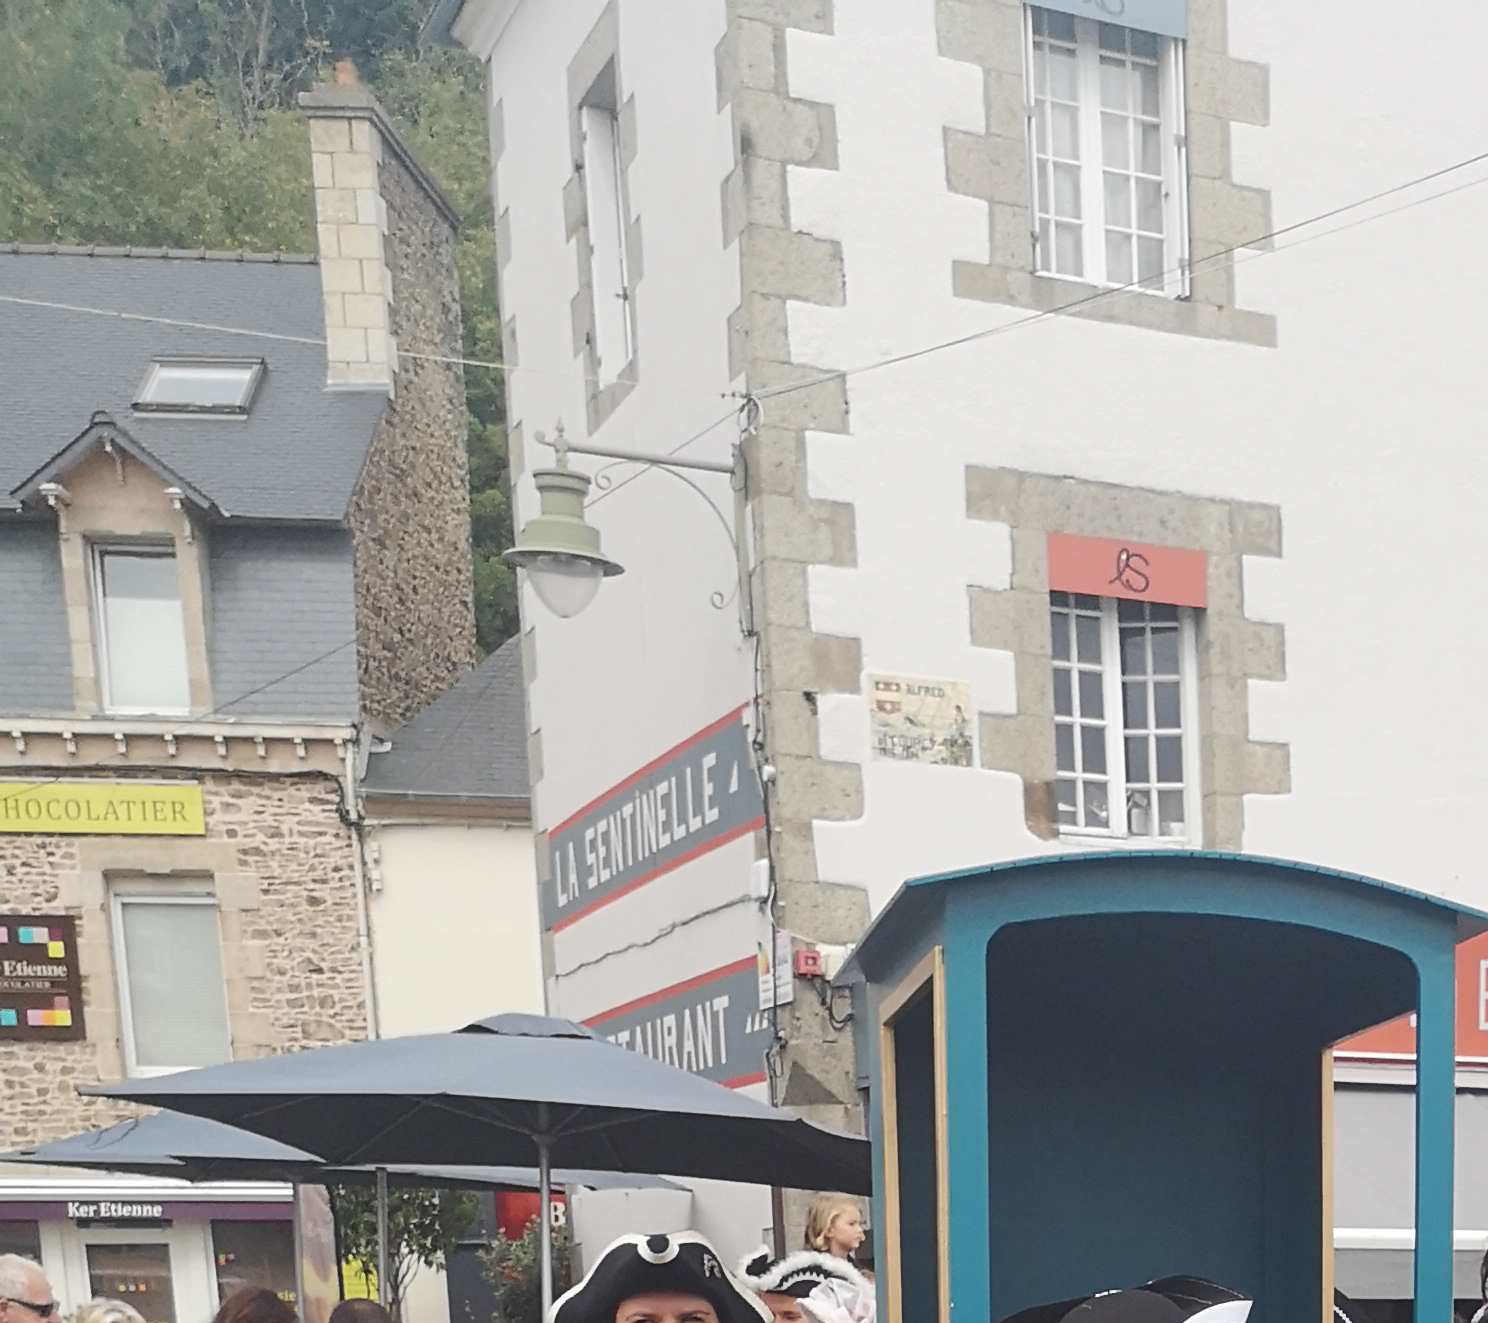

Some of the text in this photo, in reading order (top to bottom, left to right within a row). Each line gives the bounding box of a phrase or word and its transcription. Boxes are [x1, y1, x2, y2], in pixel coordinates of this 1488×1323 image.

[555, 841, 579, 908] LA
[3, 961, 68, 977] Etienne
[68, 1202, 163, 1217] Ker Etienne
